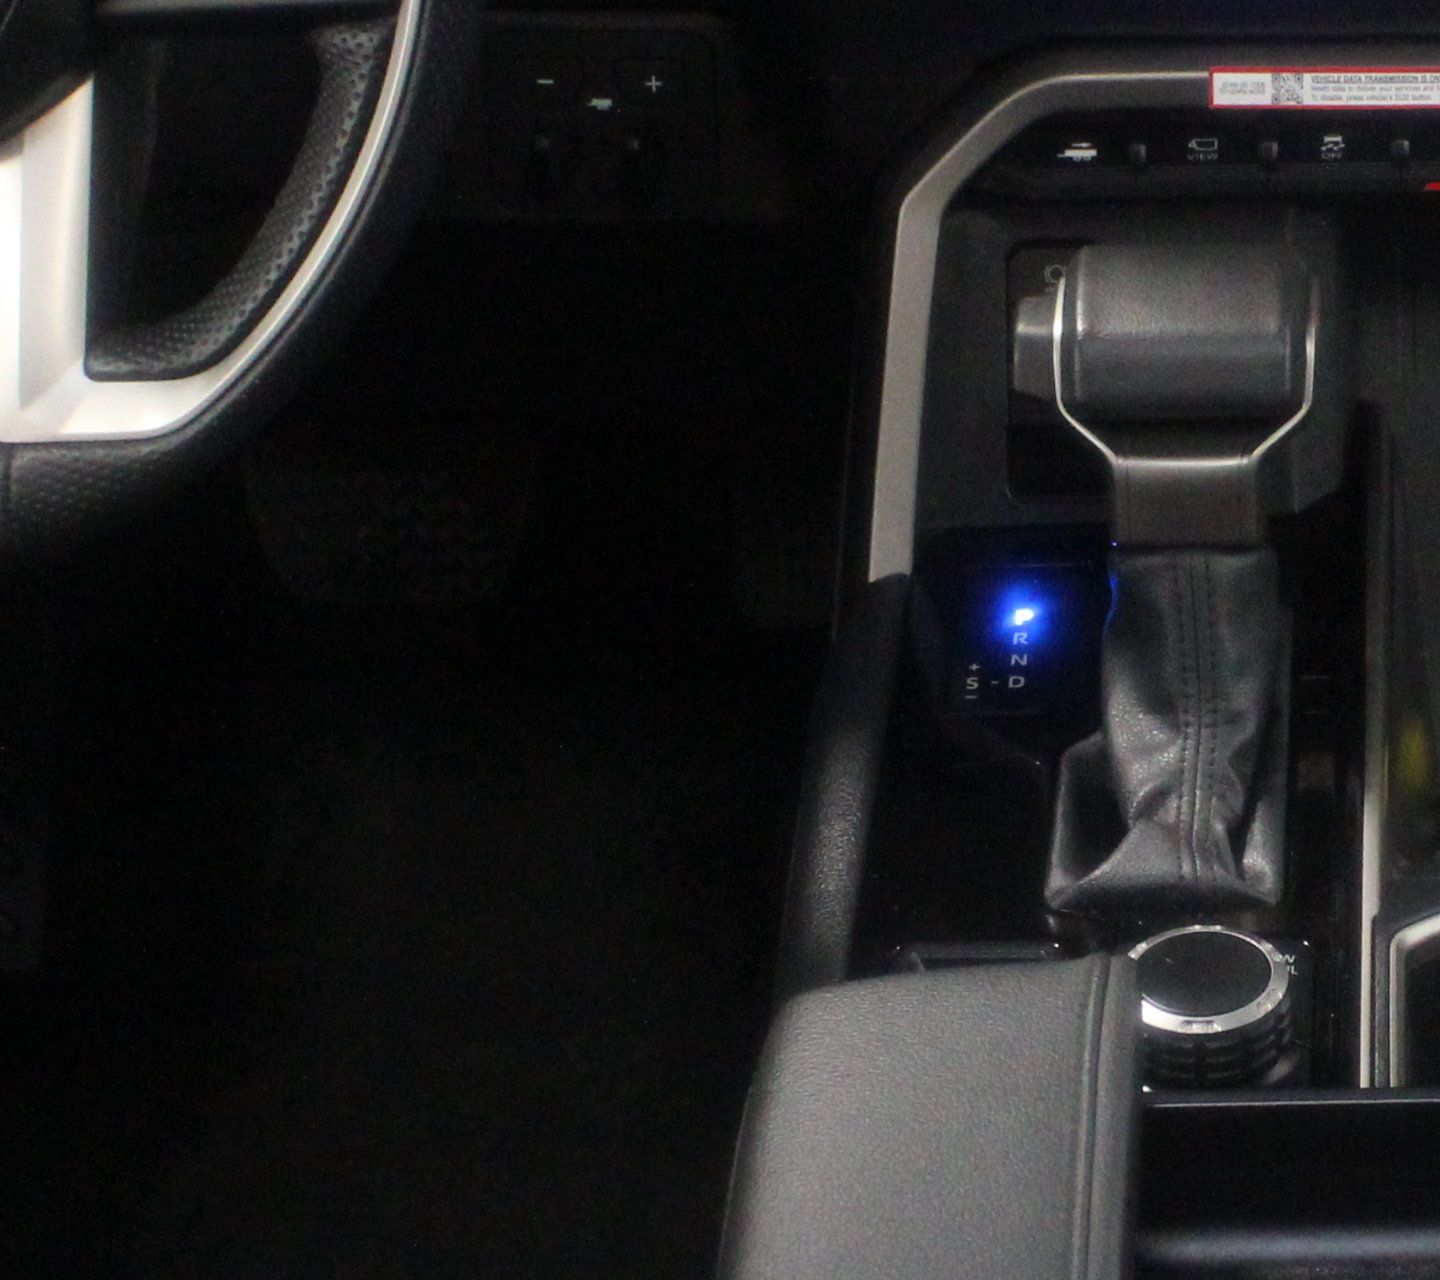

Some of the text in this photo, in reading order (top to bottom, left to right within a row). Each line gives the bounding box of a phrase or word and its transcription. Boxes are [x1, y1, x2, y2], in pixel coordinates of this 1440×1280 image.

[1013, 607, 1035, 626] P
[1012, 632, 1029, 646] R
[1010, 654, 1028, 667] N
[966, 676, 979, 690] S
[1008, 675, 1026, 689] D
